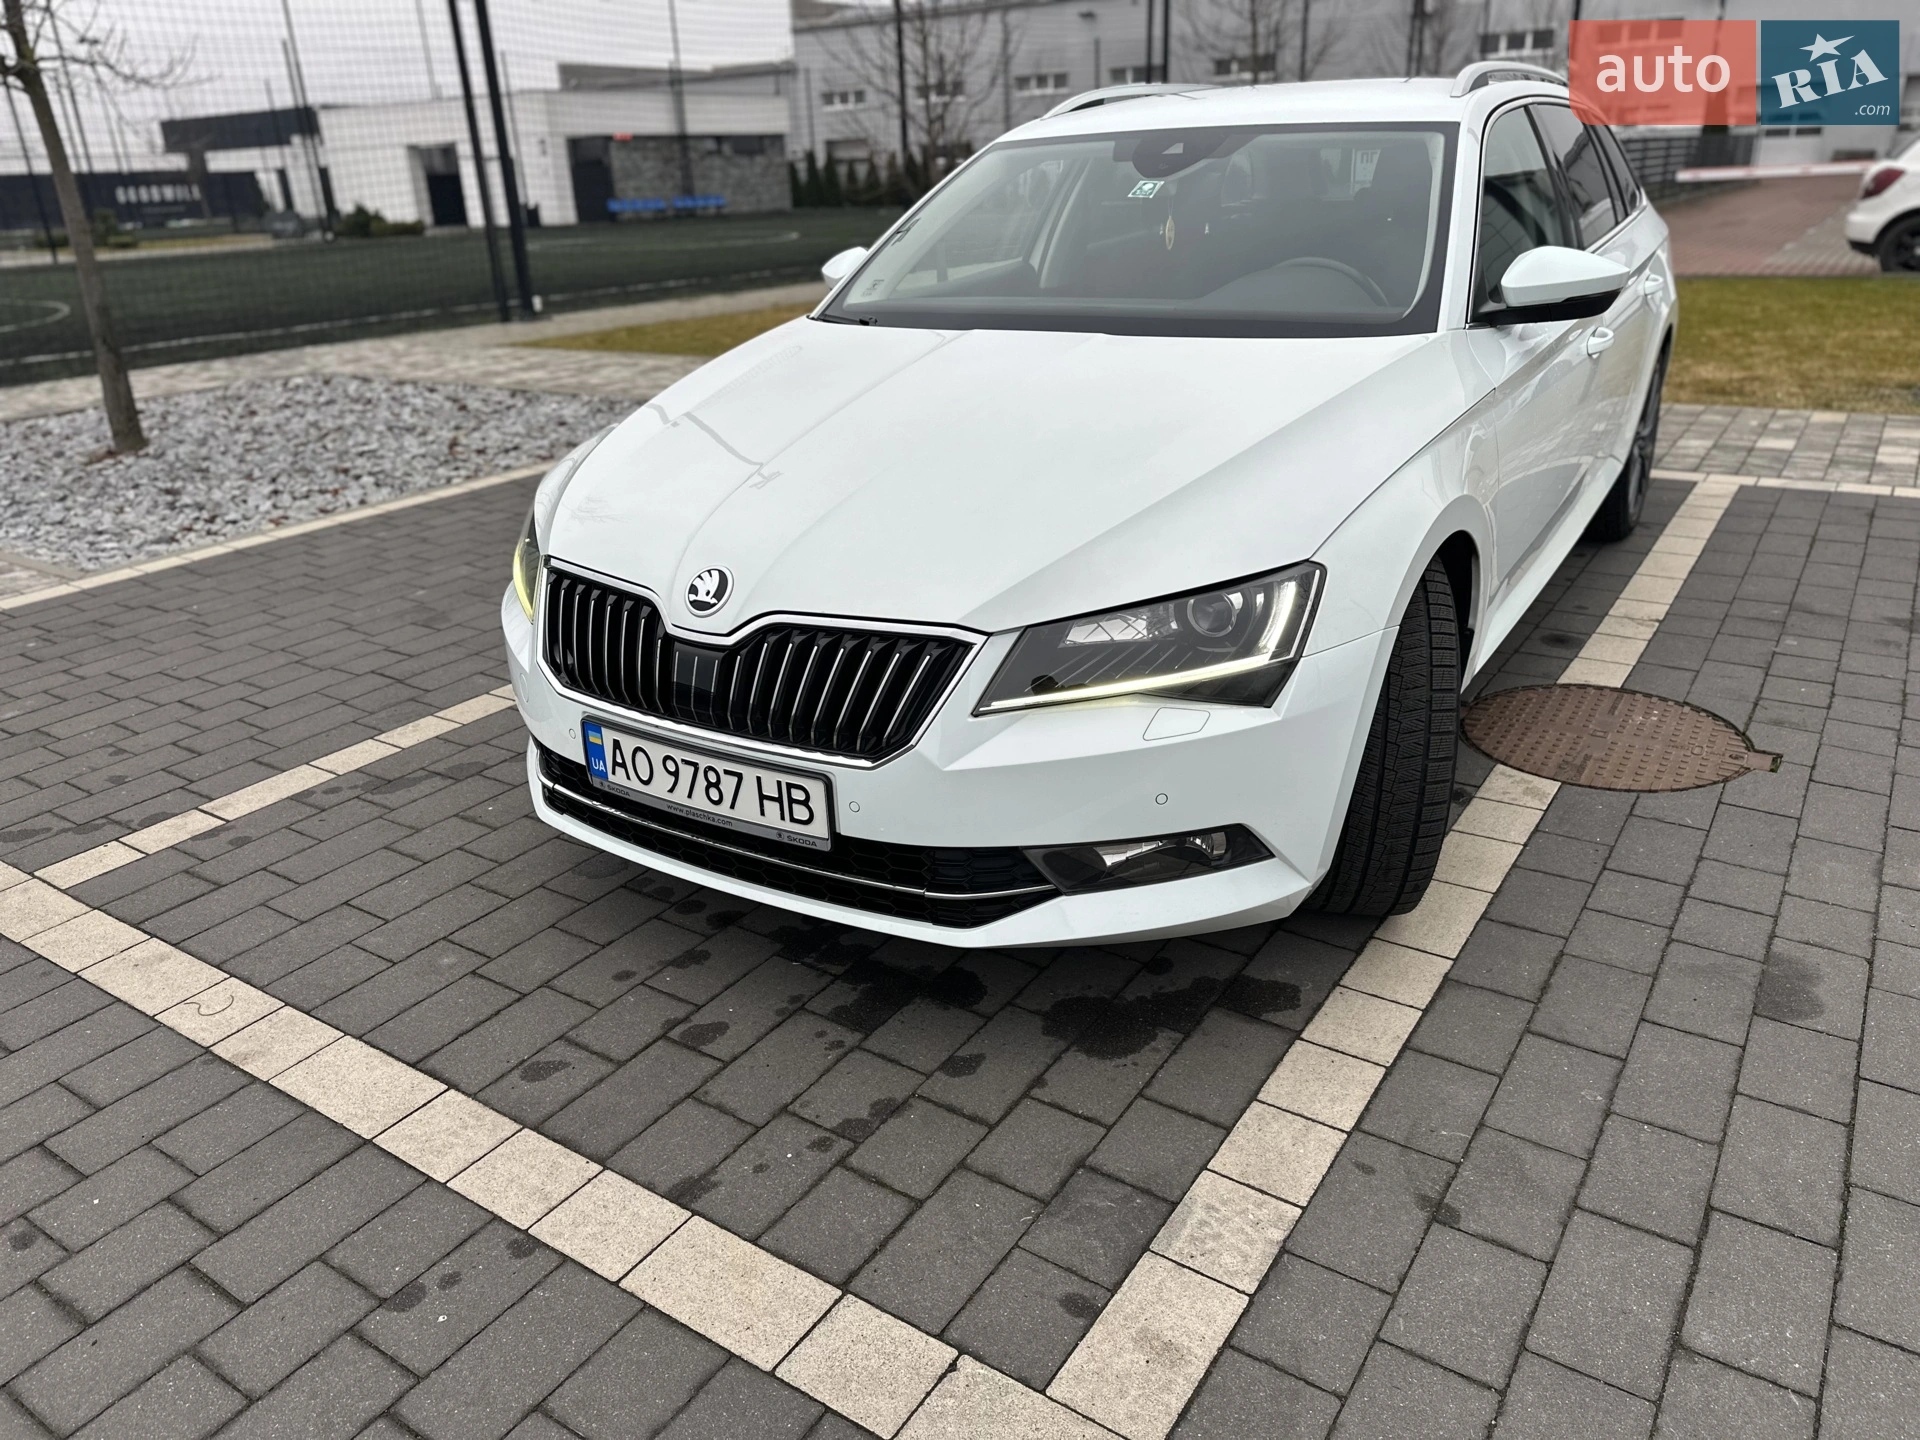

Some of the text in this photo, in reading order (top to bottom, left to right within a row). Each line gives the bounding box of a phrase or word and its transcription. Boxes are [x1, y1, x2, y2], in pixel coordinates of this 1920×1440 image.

[591, 757, 606, 773] UA
[611, 737, 815, 827] AO 9787 HB
[666, 803, 734, 827] www.plaschka.com
